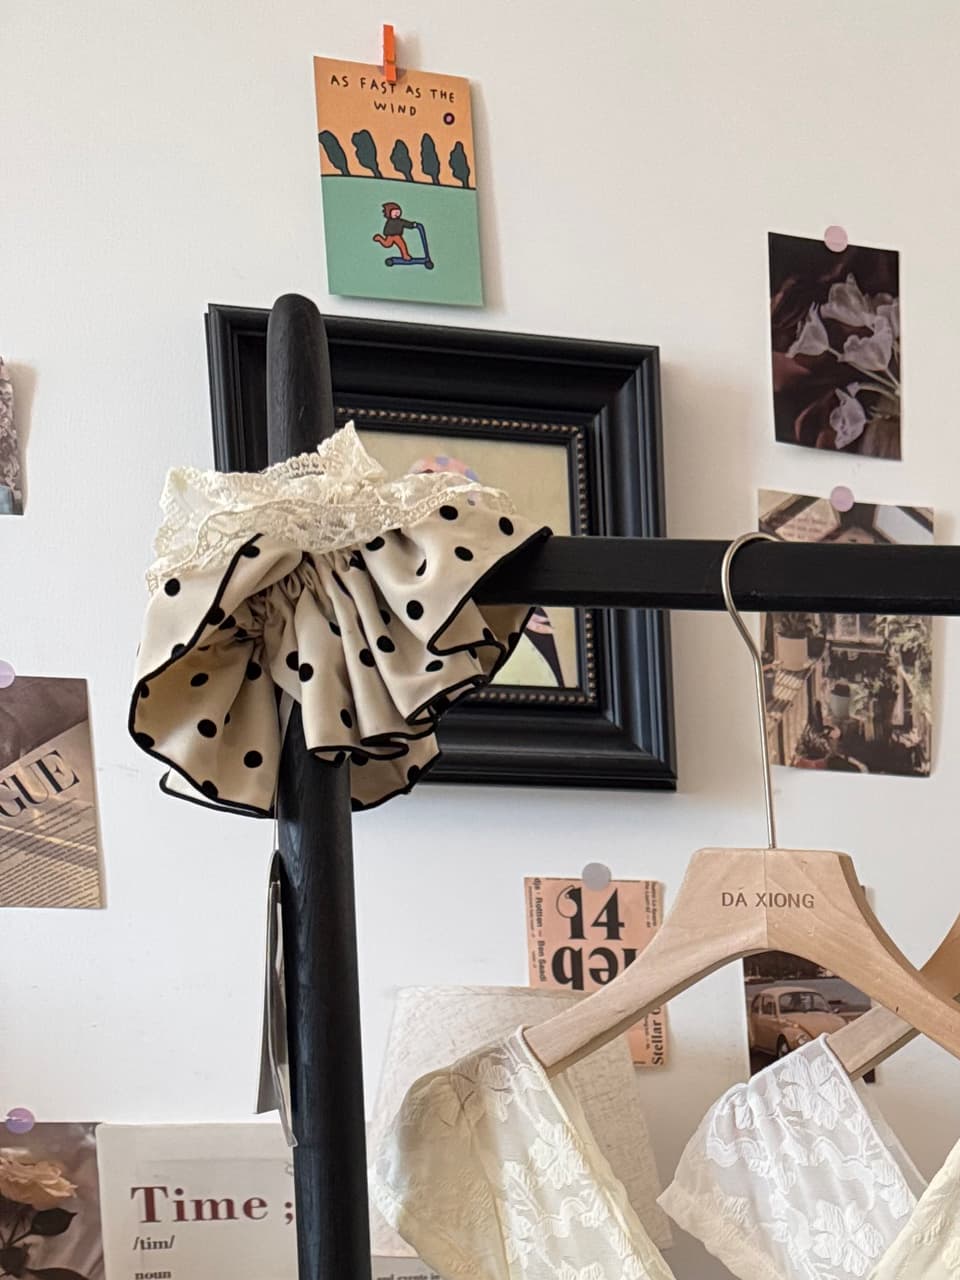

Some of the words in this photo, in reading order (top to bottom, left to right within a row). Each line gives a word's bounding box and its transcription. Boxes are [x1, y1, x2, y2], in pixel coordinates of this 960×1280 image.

[330, 74, 349, 88] AS
[360, 77, 397, 94] FAST
[405, 84, 421, 99] AS
[430, 88, 455, 103] THE
[373, 100, 417, 116] WIND
[721, 891, 748, 908] DA
[754, 891, 815, 909] XIONG
[556, 884, 625, 941] 14
[651, 1019, 665, 1066] Stellar
[130, 1185, 269, 1224] Time
[132, 1234, 176, 1251] /tim/
[134, 1270, 172, 1280] noun
